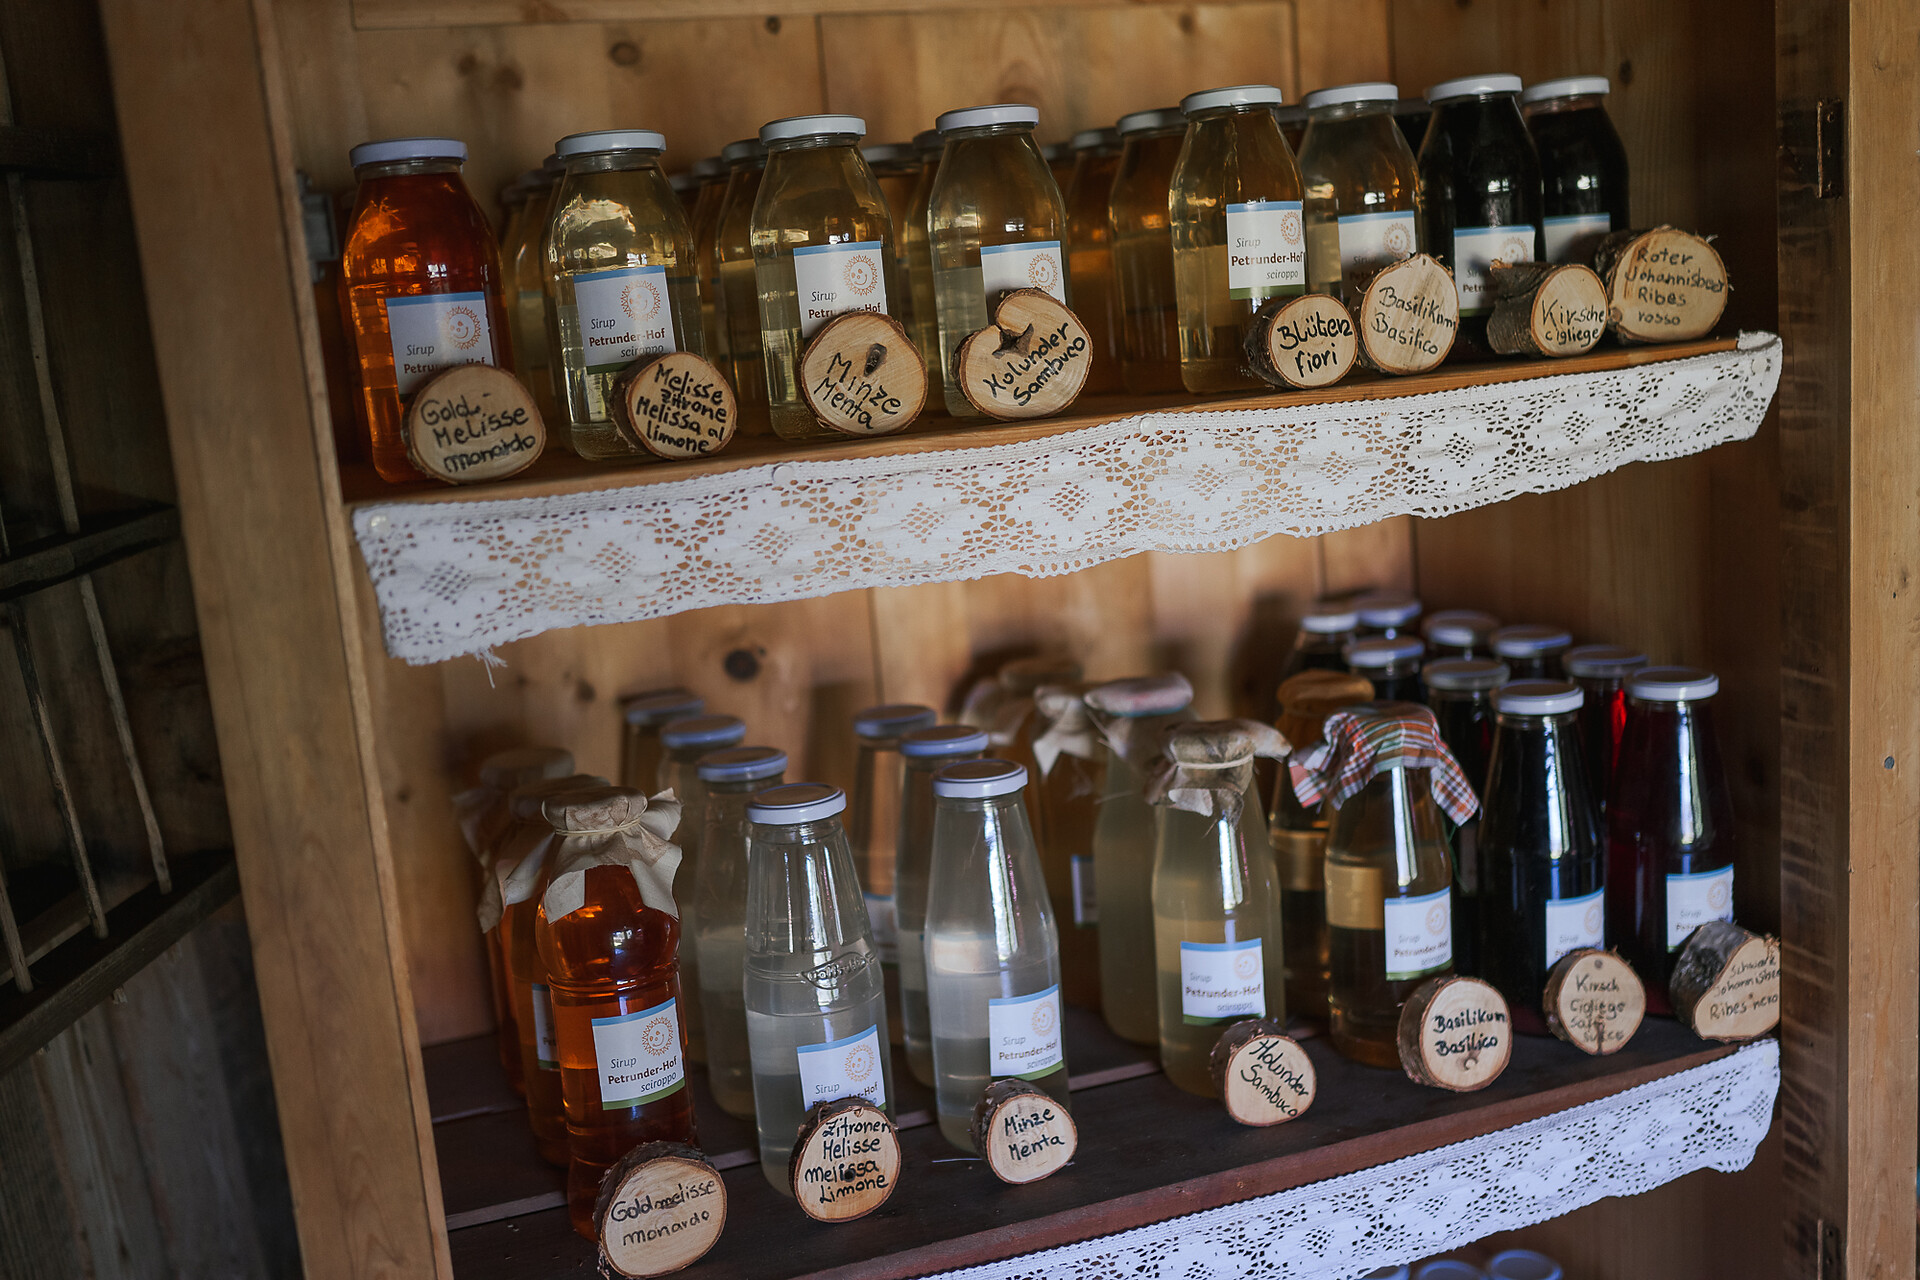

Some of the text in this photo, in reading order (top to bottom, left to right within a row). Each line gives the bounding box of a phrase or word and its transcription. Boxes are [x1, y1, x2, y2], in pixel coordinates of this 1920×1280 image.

[1236, 237, 1261, 248] Sirup
[1231, 251, 1303, 267] Petrunder-Hof
[1637, 248, 1694, 266] Roter
[1266, 269, 1299, 281] sciroppo
[812, 291, 838, 303] Sirup
[1638, 286, 1686, 306] Ribes
[1379, 286, 1457, 331] Basilikum
[1541, 299, 1605, 331] Kirsche
[1639, 311, 1681, 326] rosso
[591, 317, 617, 330] Sirup
[1371, 311, 1439, 355] Basilico
[588, 327, 666, 347] Petrunder-Hof
[406, 344, 435, 357] Sirup
[654, 364, 724, 406] Melisse
[826, 352, 902, 415] Minze
[813, 376, 874, 430] Menta
[432, 407, 530, 448] Melisse
[635, 396, 725, 442] Melissa al
[1185, 983, 1262, 999] Petrunder-Hof
[1575, 972, 1620, 993] Kirsch
[1432, 1008, 1508, 1034] Basilikum
[1710, 1001, 1748, 1021] Ribes
[999, 1038, 1058, 1061] Petrunder-Hof
[1002, 1036, 1027, 1047] Sirup
[1434, 1031, 1499, 1057] Basilico
[607, 1055, 677, 1086] Petrunder-Hof
[611, 1055, 637, 1070] Sirup
[640, 1070, 677, 1093] sciroppo
[815, 1083, 840, 1095] Sirup
[1240, 1063, 1299, 1118] Sambuco
[821, 1116, 892, 1138] Zitronen
[1004, 1107, 1056, 1137] Minze
[822, 1137, 882, 1162] Melisse
[1008, 1133, 1065, 1161] Menta
[804, 1159, 880, 1184] Melissa
[819, 1173, 889, 1204] Limone
